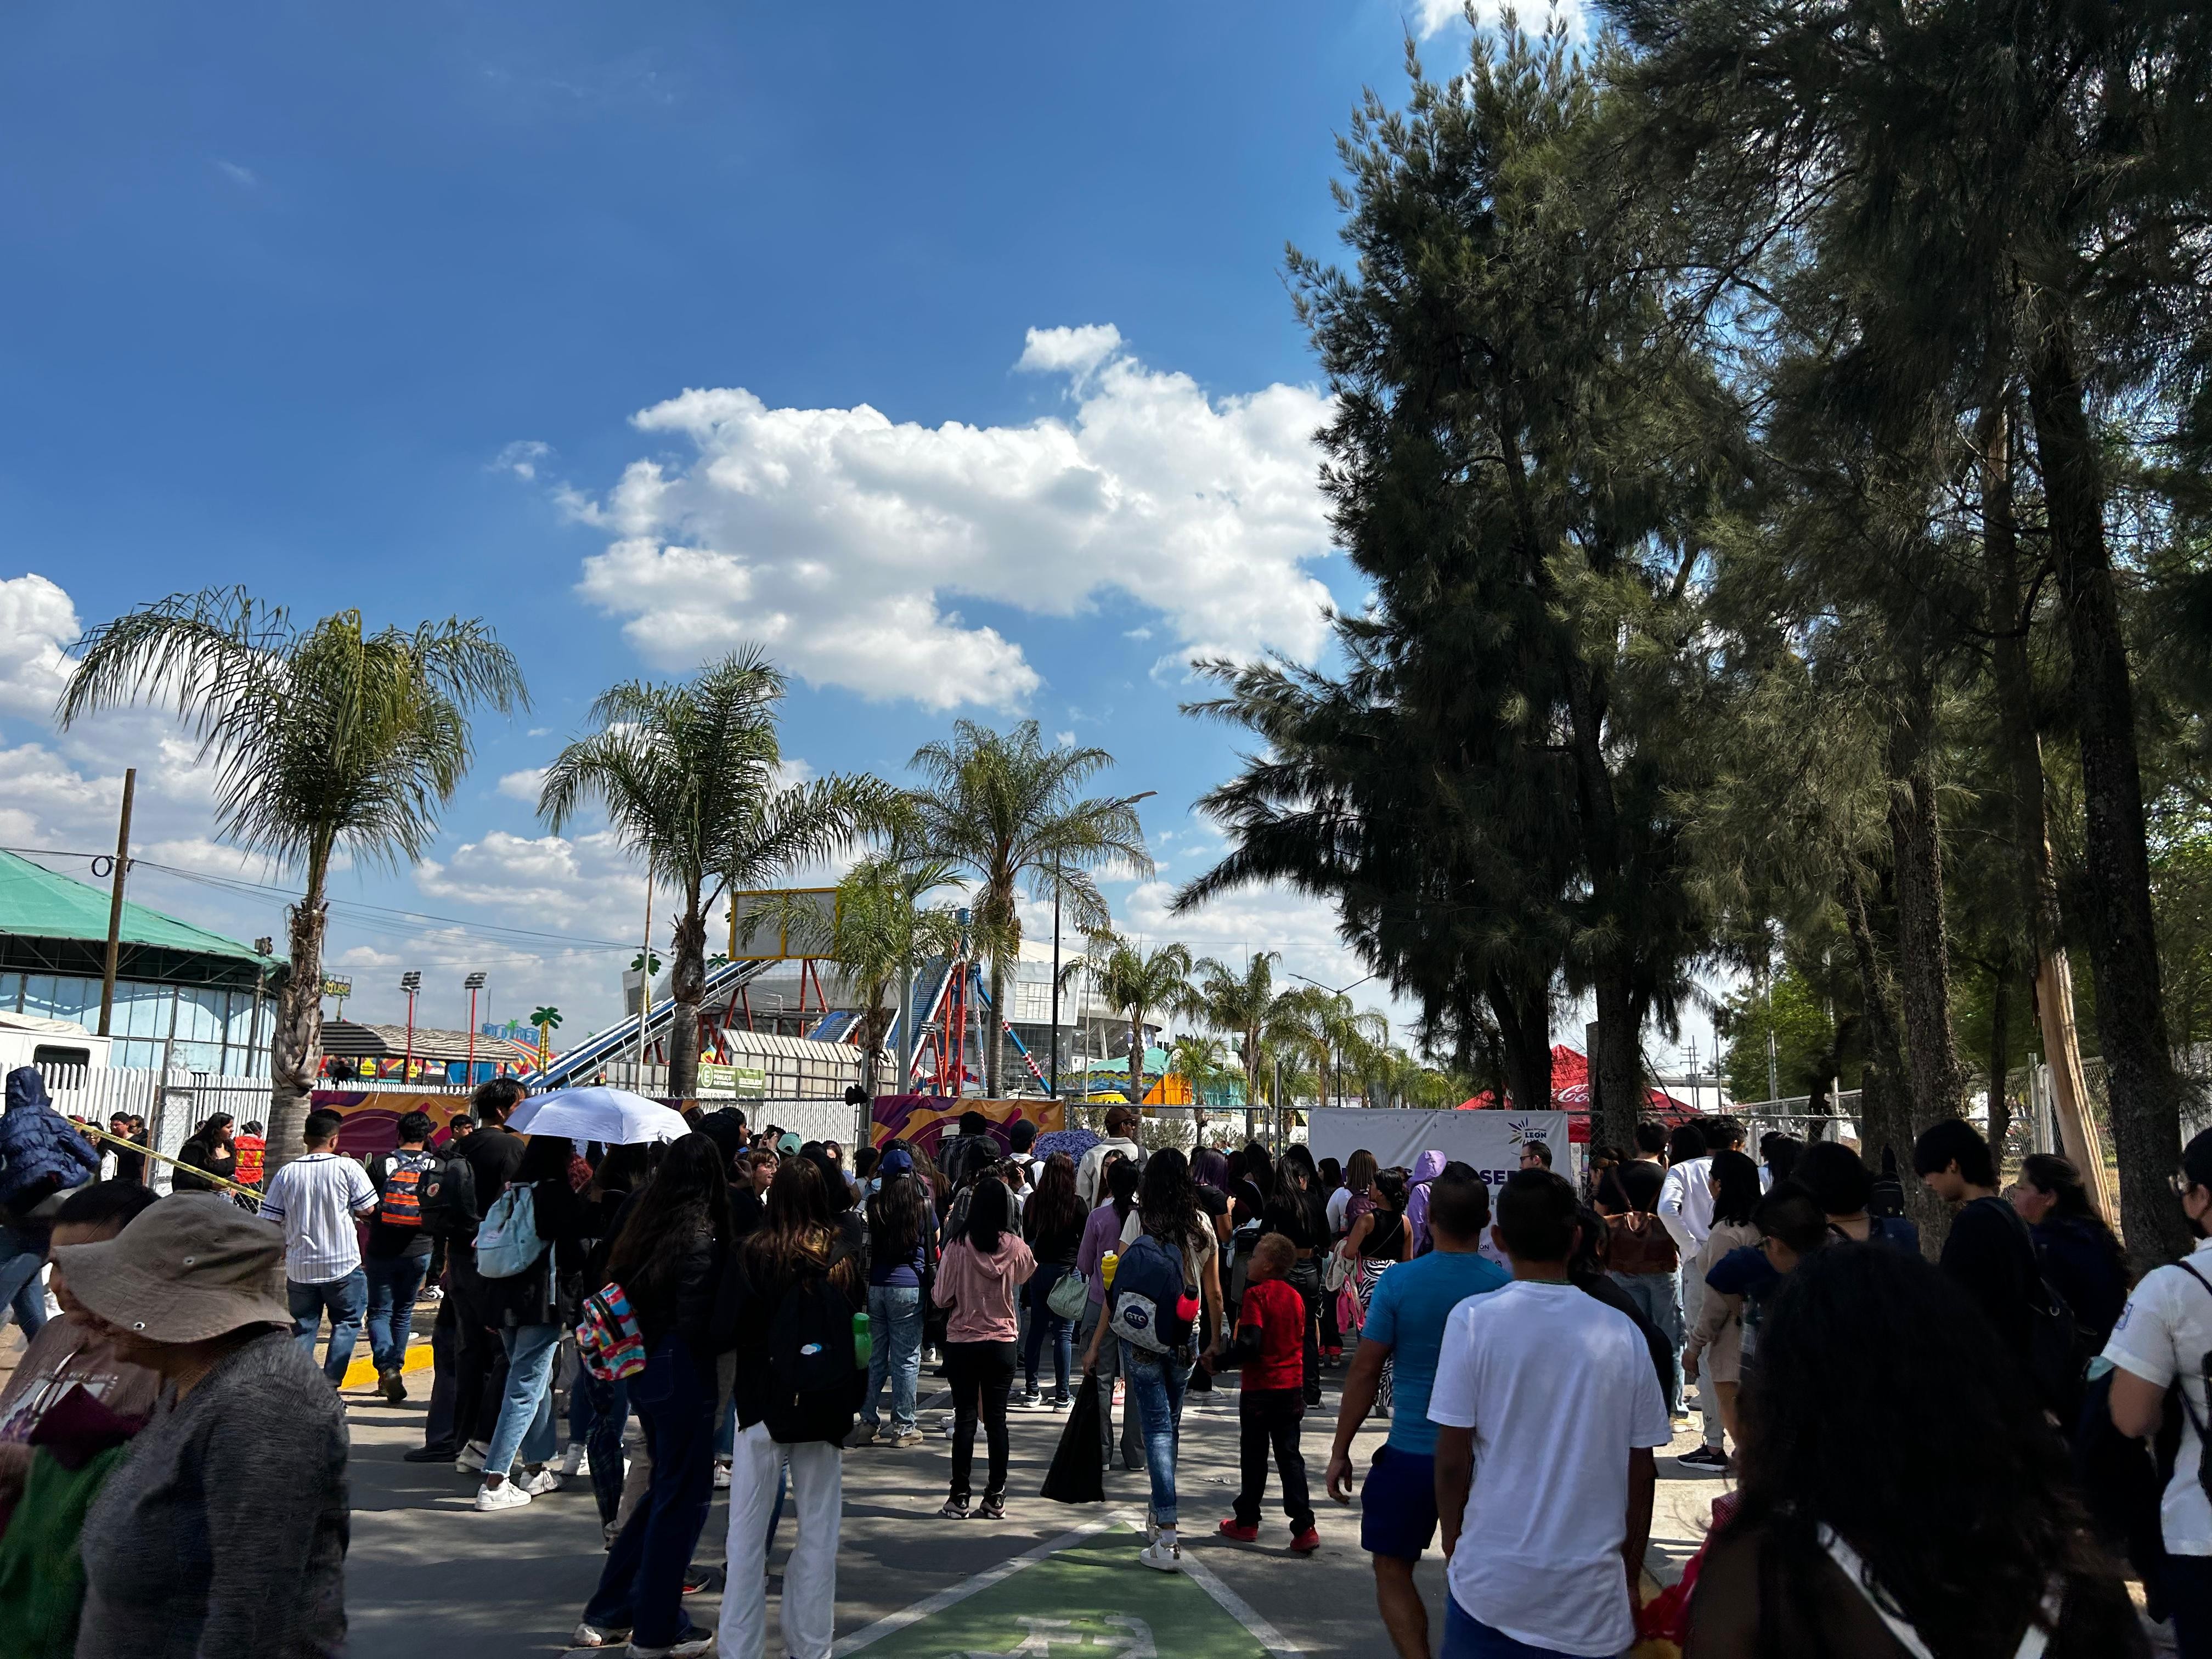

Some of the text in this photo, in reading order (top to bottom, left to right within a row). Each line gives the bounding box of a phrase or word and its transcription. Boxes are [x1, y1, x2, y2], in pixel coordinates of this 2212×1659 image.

[704, 1070, 710, 1083] E
[1557, 1084, 1589, 1103] Co
[1525, 1130, 1547, 1138] LEÓN
